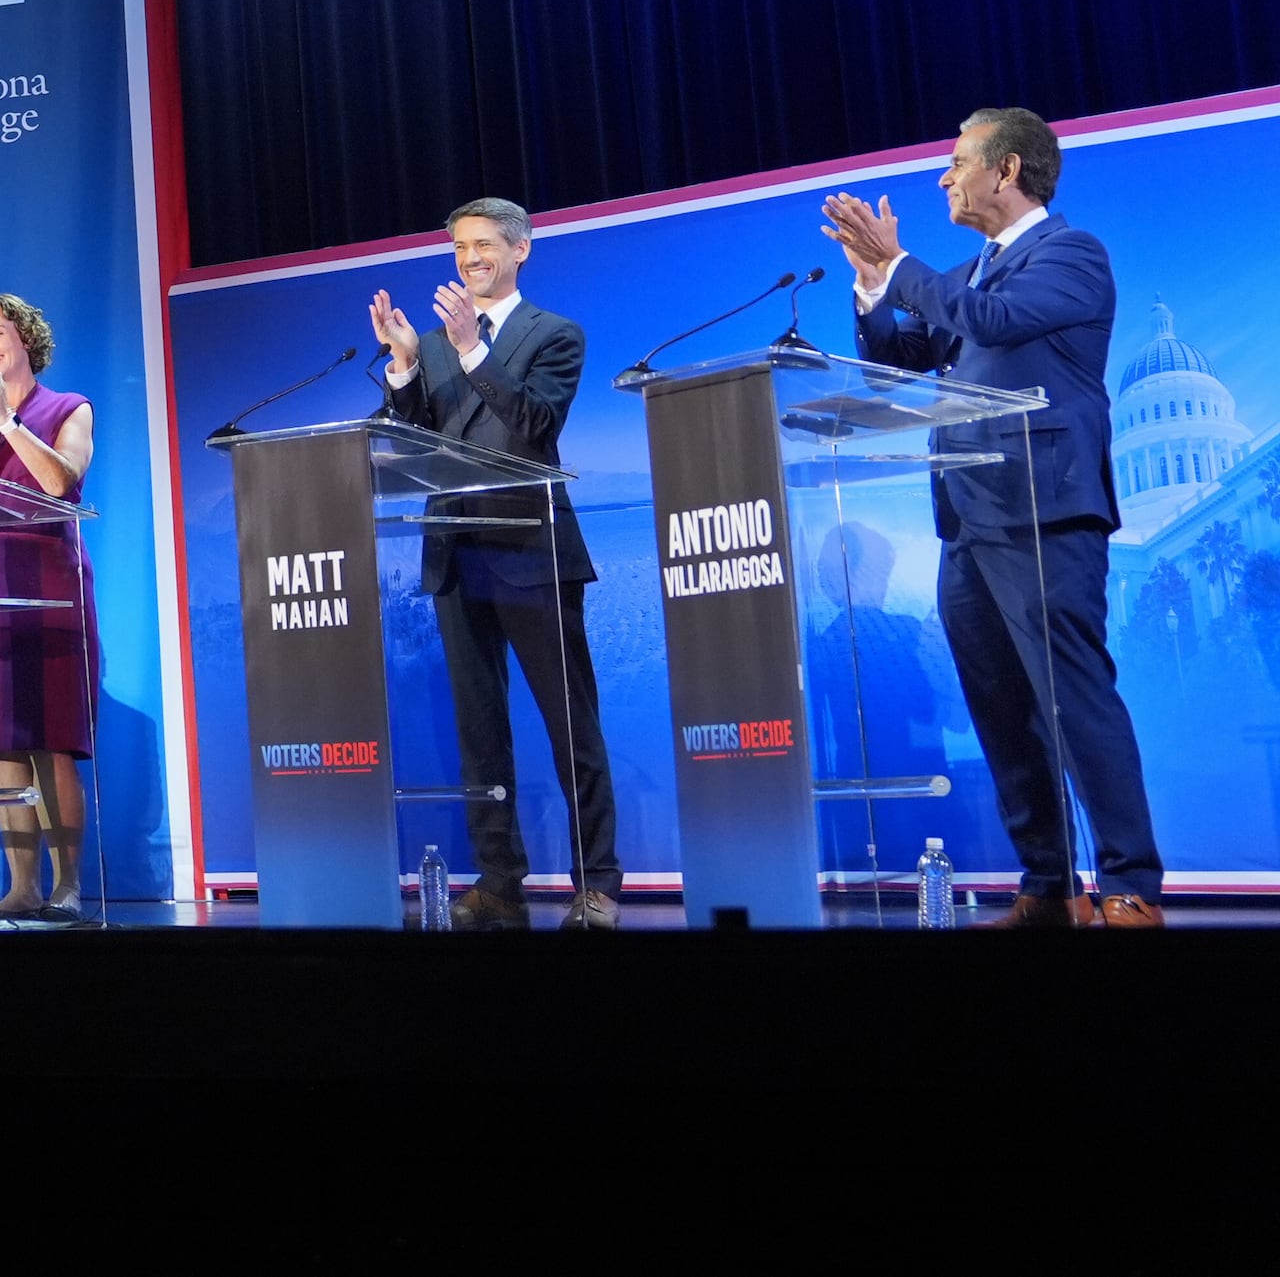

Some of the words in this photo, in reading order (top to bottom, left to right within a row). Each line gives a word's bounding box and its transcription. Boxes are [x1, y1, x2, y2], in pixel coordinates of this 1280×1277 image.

[668, 498, 773, 559] ANTONIO
[266, 550, 346, 597] MATT
[663, 551, 785, 598] VILLARAIGOSA
[270, 597, 349, 631] MAHAN
[260, 742, 322, 770] VOTERS
[322, 740, 380, 767] DECIDE
[681, 723, 740, 753] VOTERS
[739, 719, 794, 749] DECIDE
